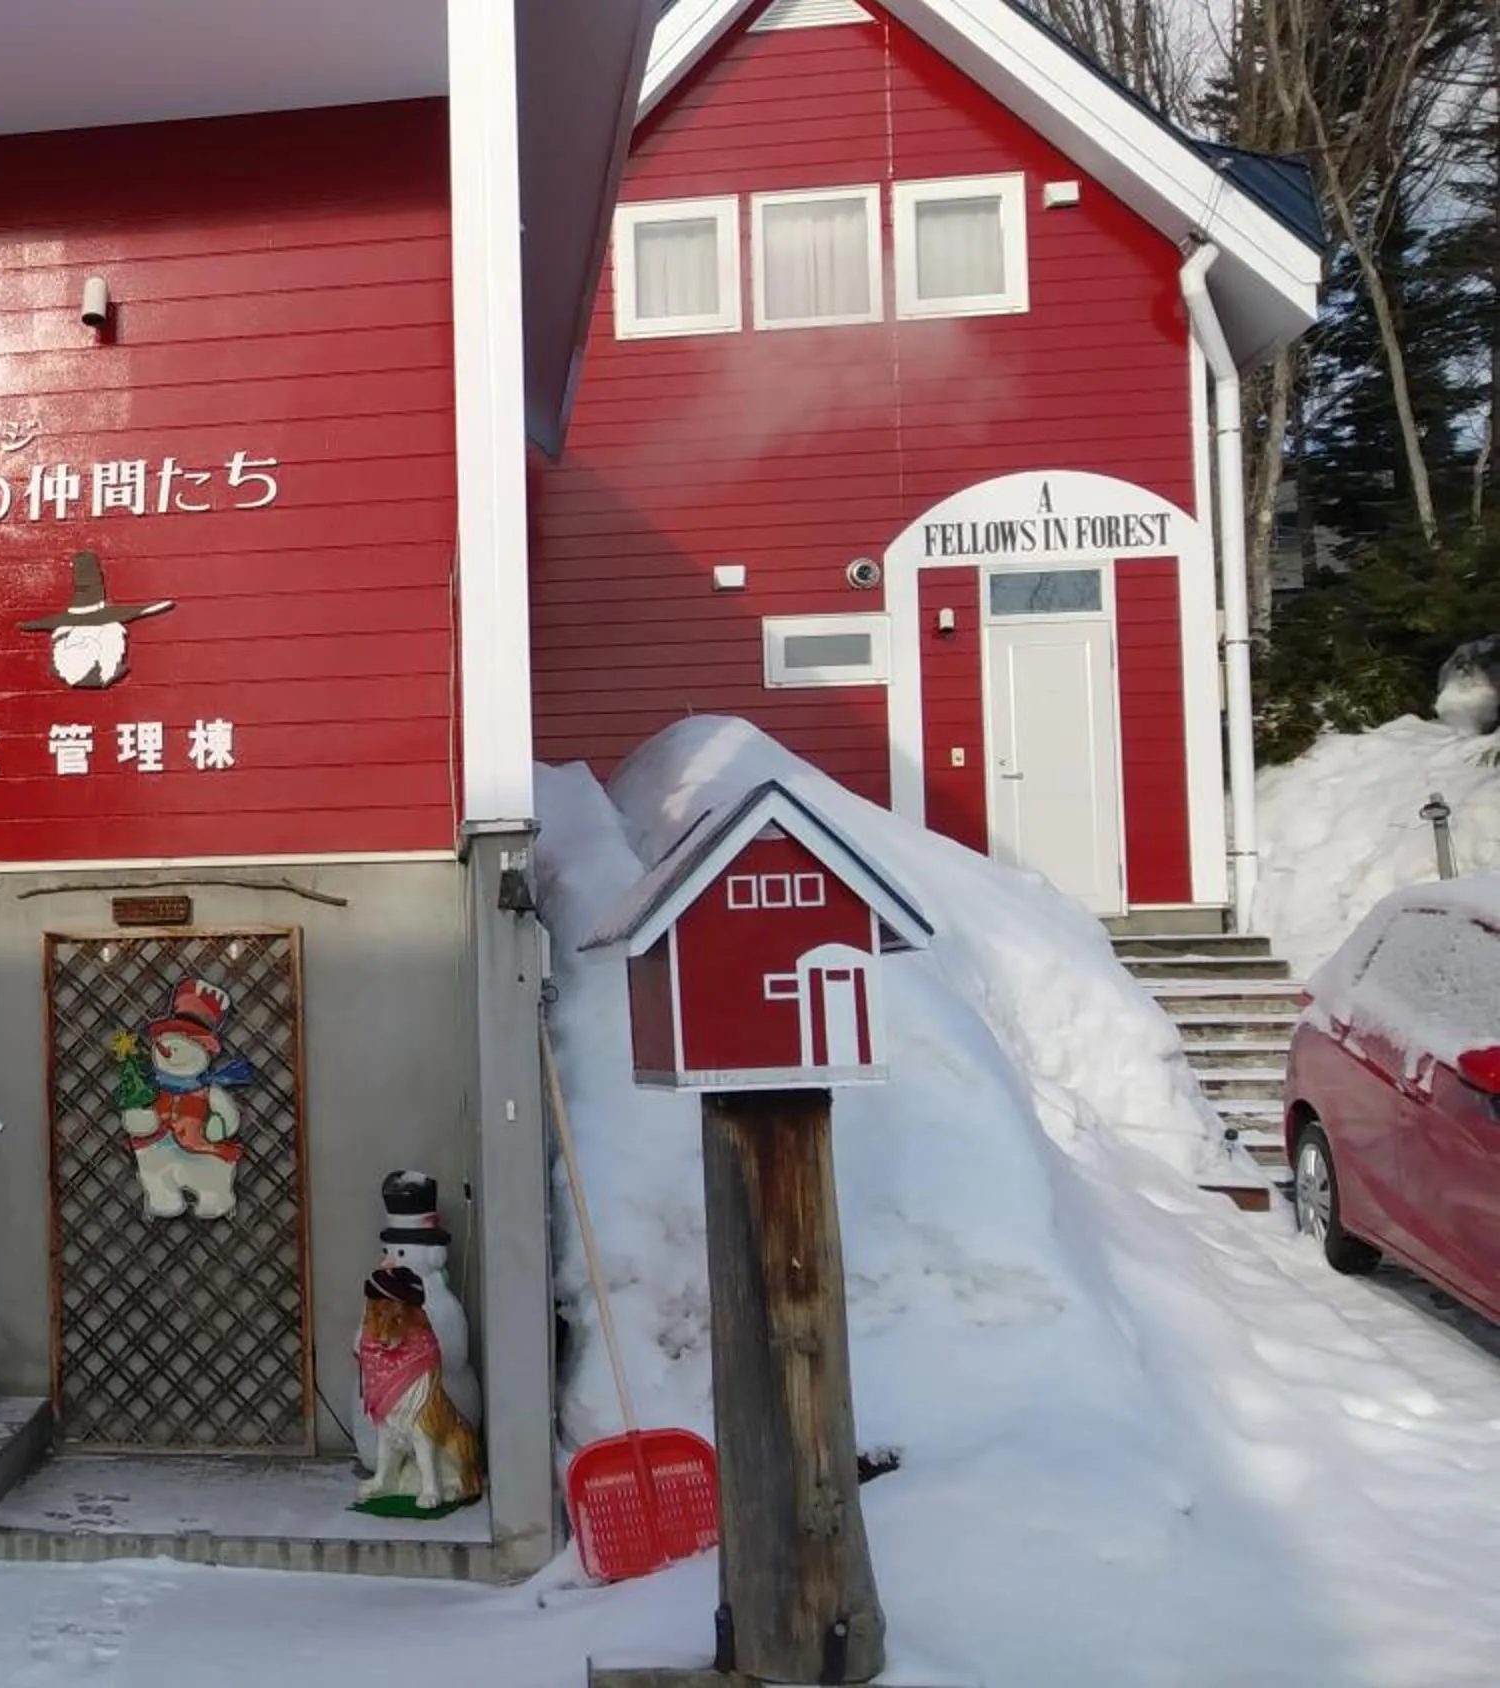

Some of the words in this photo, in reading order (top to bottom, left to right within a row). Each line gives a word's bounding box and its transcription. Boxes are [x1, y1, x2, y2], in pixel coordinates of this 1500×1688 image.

[1036, 480, 1054, 514] A
[924, 518, 1038, 557] FELLOWS
[1043, 517, 1069, 551] IN
[1075, 513, 1172, 549] FOREST
[47, 717, 237, 776] 管理棟
